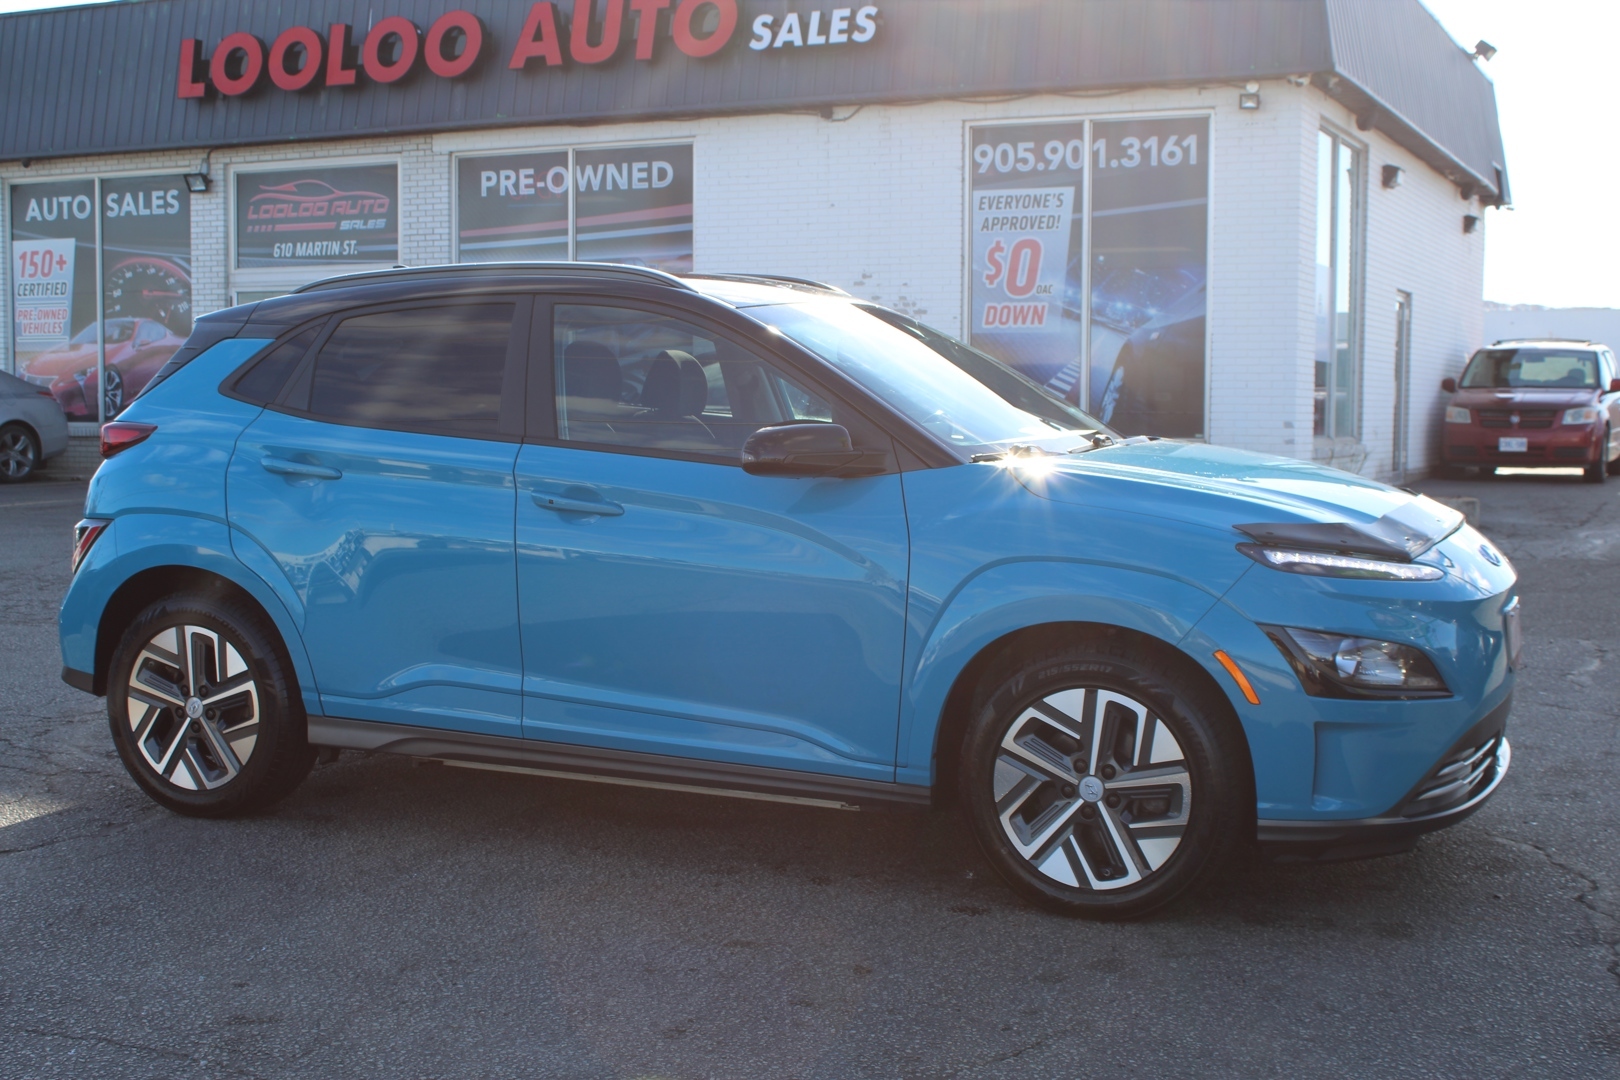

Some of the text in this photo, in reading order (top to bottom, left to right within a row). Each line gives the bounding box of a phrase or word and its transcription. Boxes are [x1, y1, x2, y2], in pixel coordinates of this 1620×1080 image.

[749, 6, 878, 50] SALES
[178, 0, 738, 98] LOOLOO AUTO
[973, 134, 1198, 173] 905.901.3161
[480, 160, 674, 197] PRE-OWNED
[25, 189, 180, 222] AUTO SALES
[247, 199, 390, 219] LOOLOO AUTO
[978, 193, 1064, 211] EVERYONE'S
[340, 219, 387, 231] SALES
[981, 215, 1061, 232] APPROVED!
[273, 240, 358, 258] 610 MARTIN ST.
[18, 249, 68, 279] 150+
[984, 238, 1042, 297] $0
[17, 281, 67, 297] CERTIFIED
[17, 308, 68, 321] PRE-OWNED
[984, 304, 1047, 326] DOWN
[22, 321, 63, 335] VEHICLES
